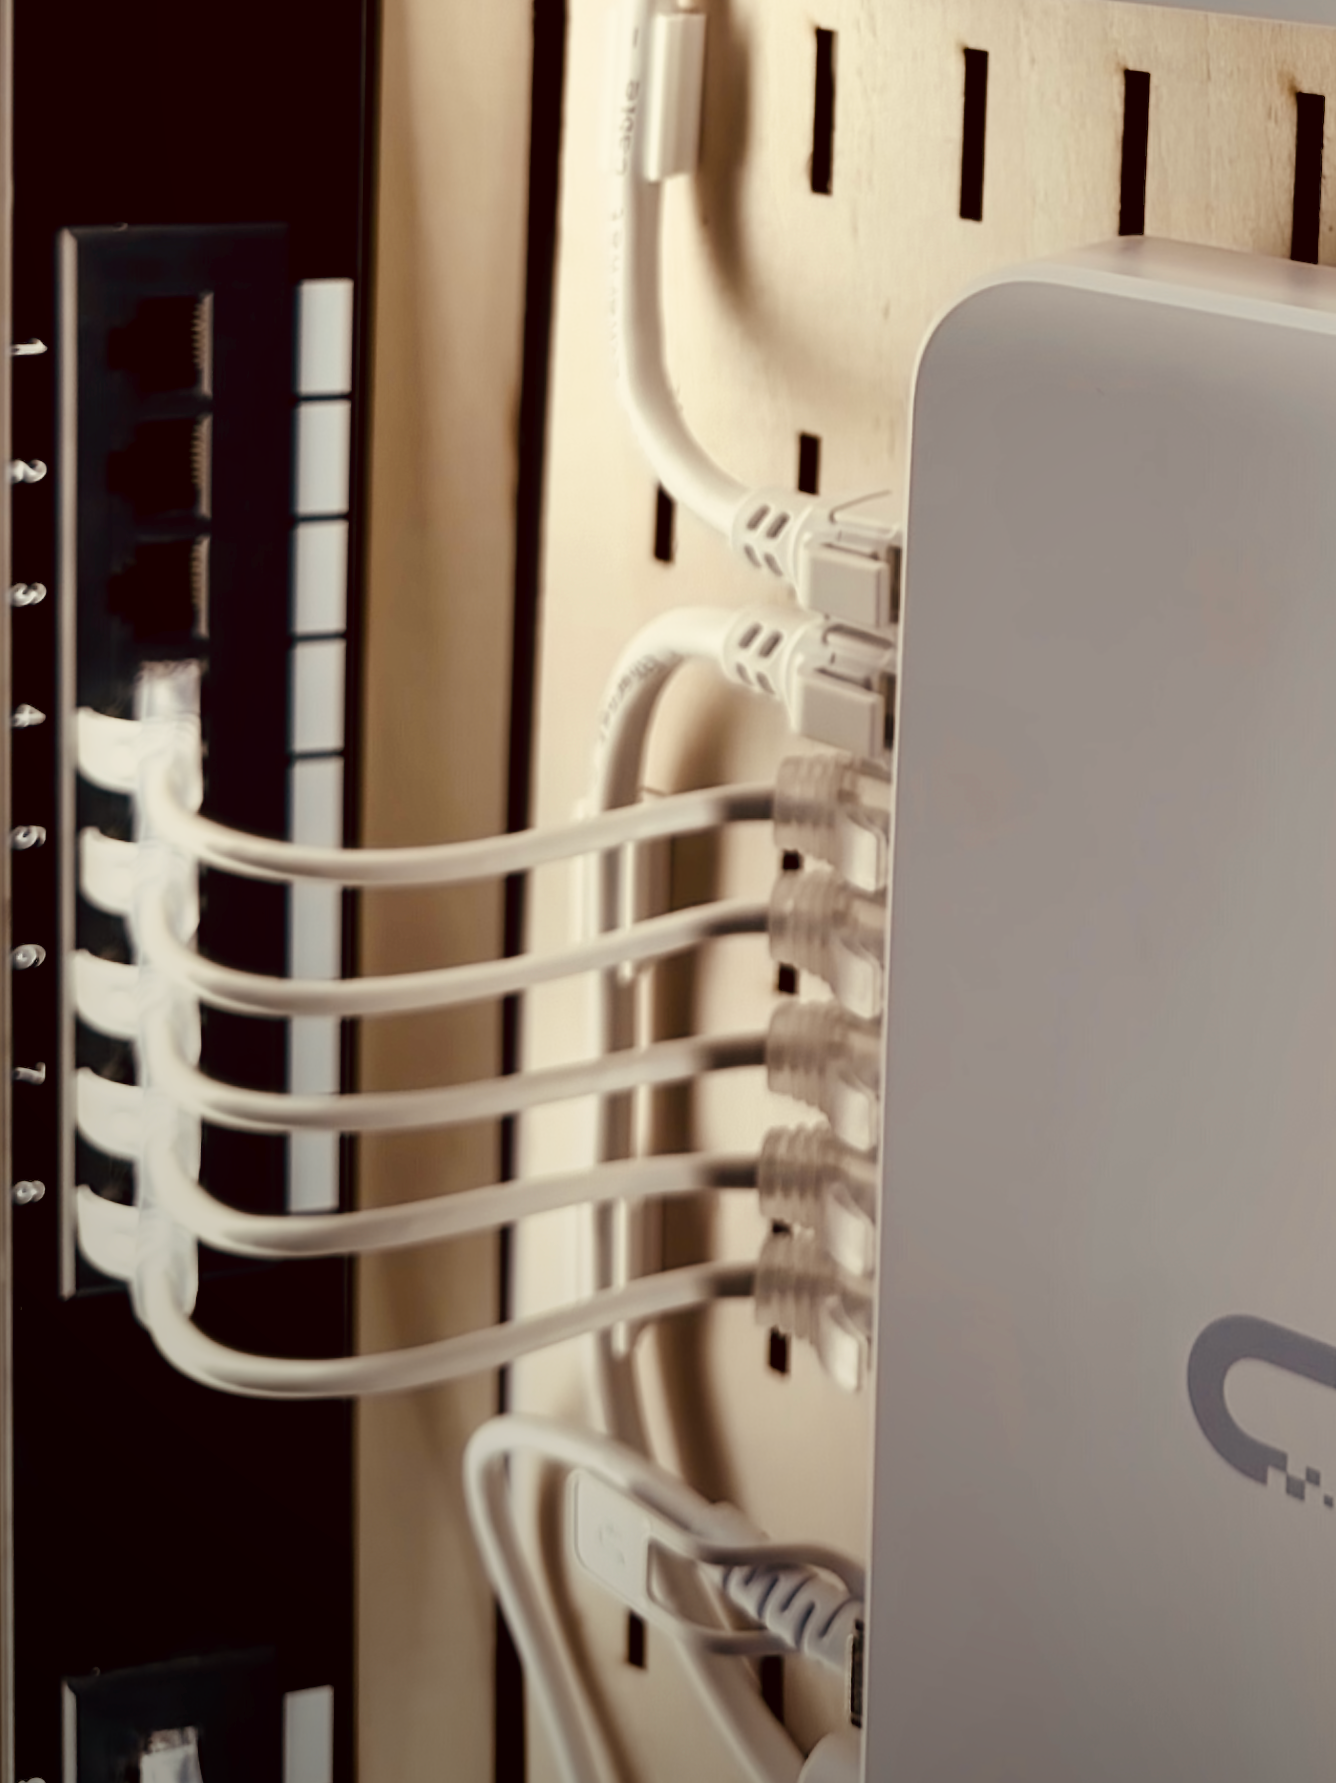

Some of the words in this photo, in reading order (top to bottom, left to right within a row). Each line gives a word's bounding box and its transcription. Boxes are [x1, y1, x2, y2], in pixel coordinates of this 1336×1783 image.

[12, 339, 48, 356] 1
[12, 459, 47, 483] 2
[12, 582, 47, 607] 3
[13, 1180, 46, 1203] 8
